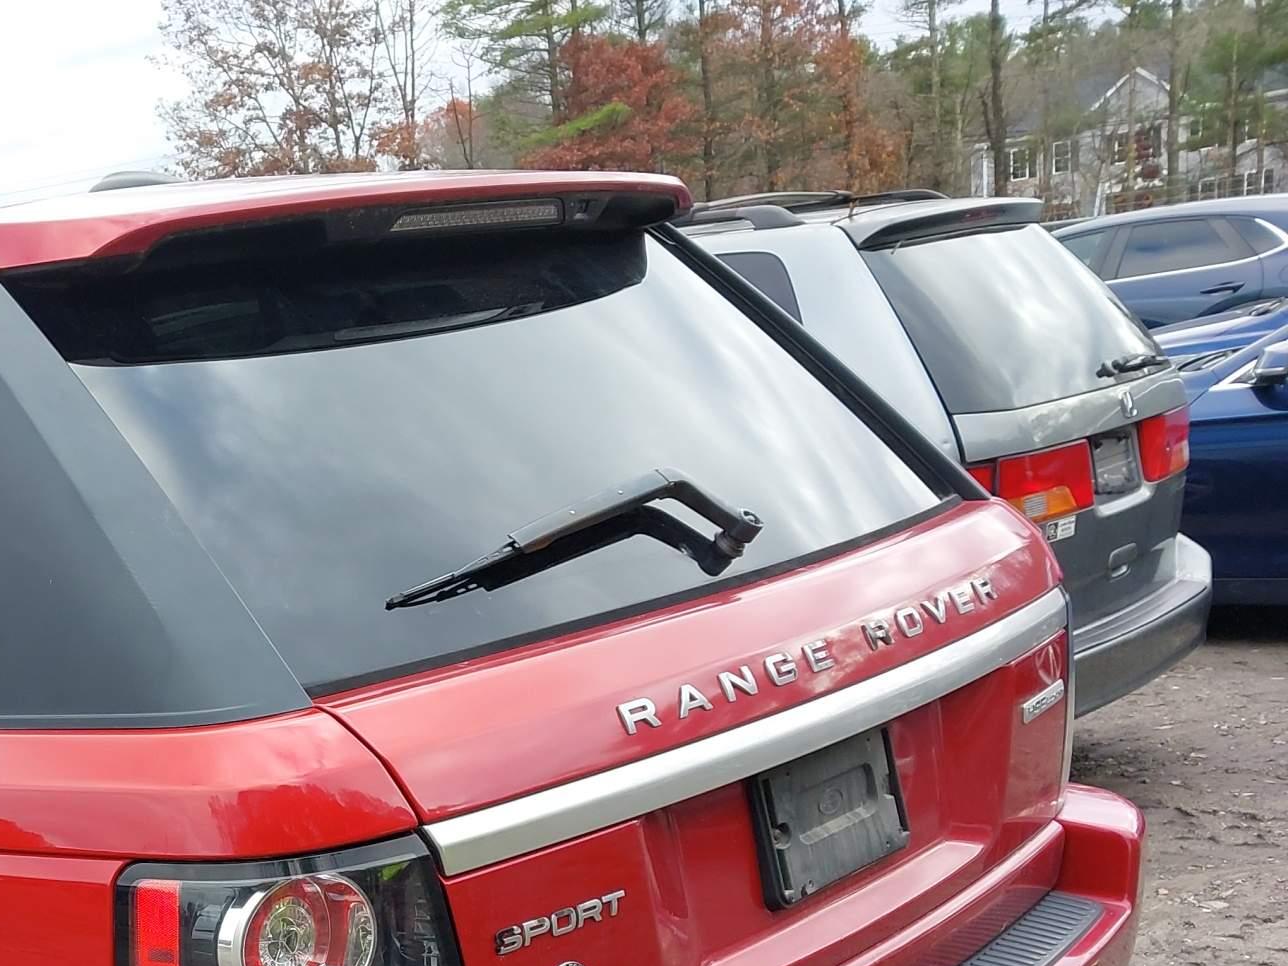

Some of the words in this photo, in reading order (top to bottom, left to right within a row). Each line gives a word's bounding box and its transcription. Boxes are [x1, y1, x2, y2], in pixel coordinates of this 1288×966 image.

[616, 638, 836, 735] RANGE
[861, 576, 998, 651] ROVER
[496, 889, 626, 955] SPORT
